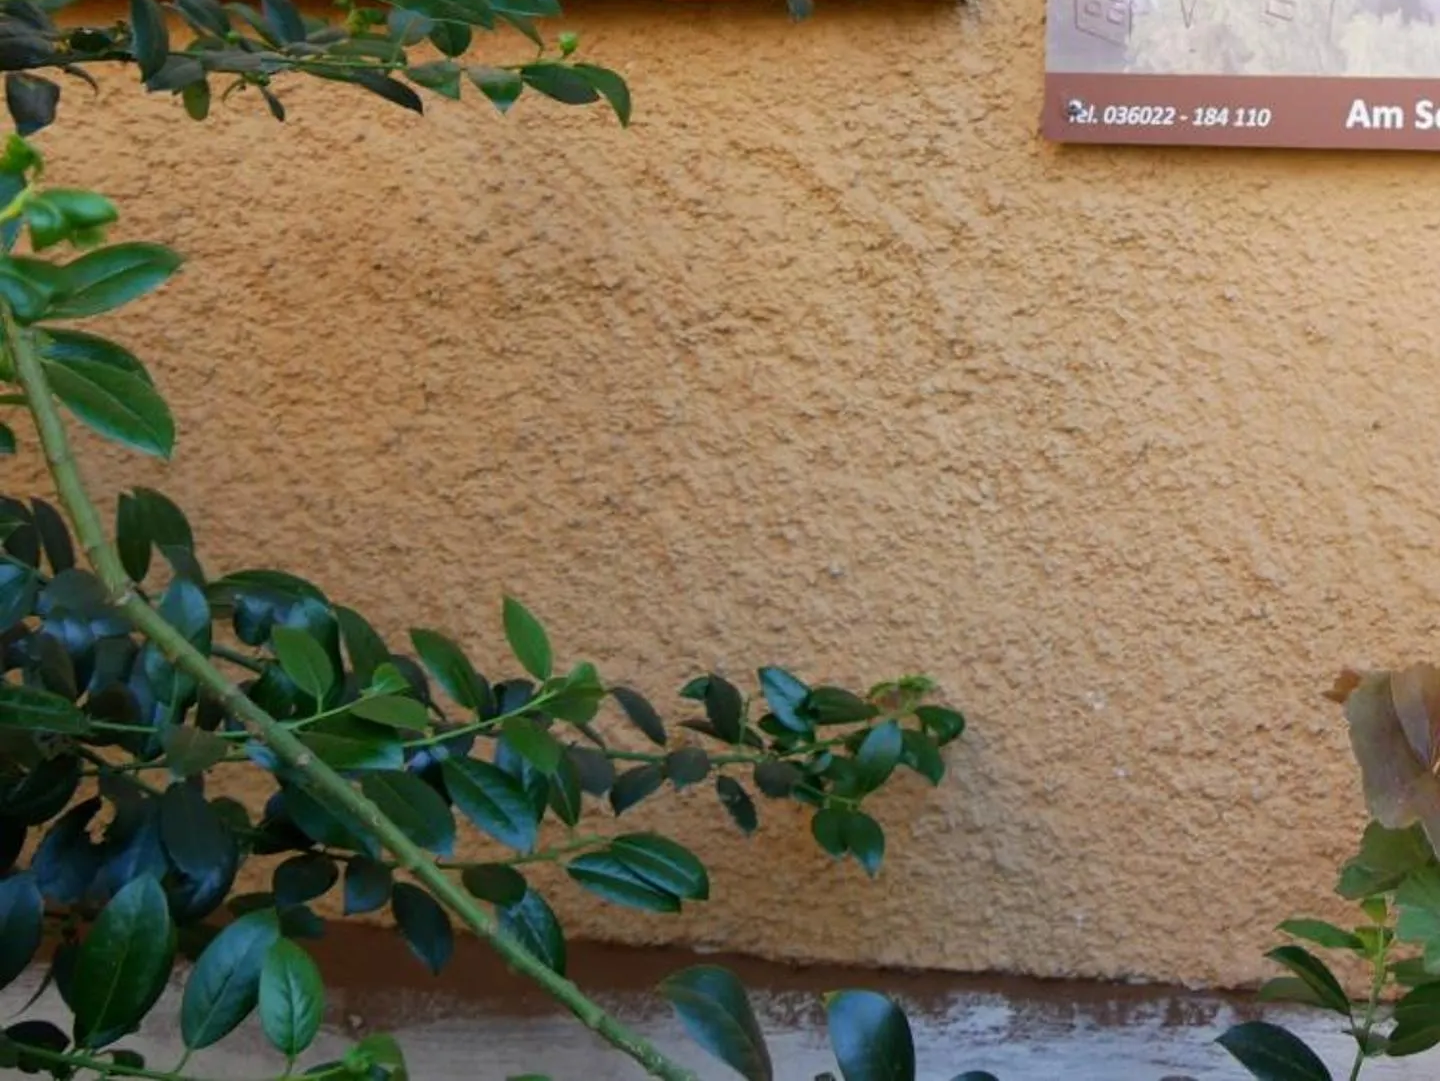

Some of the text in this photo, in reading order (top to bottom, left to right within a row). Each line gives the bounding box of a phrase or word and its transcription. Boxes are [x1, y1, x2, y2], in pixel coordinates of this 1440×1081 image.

[1069, 103, 1099, 125] el.
[1103, 105, 1177, 126] 036022
[1191, 106, 1228, 127] 184
[1233, 107, 1271, 128] 110
[1345, 99, 1403, 130] Am
